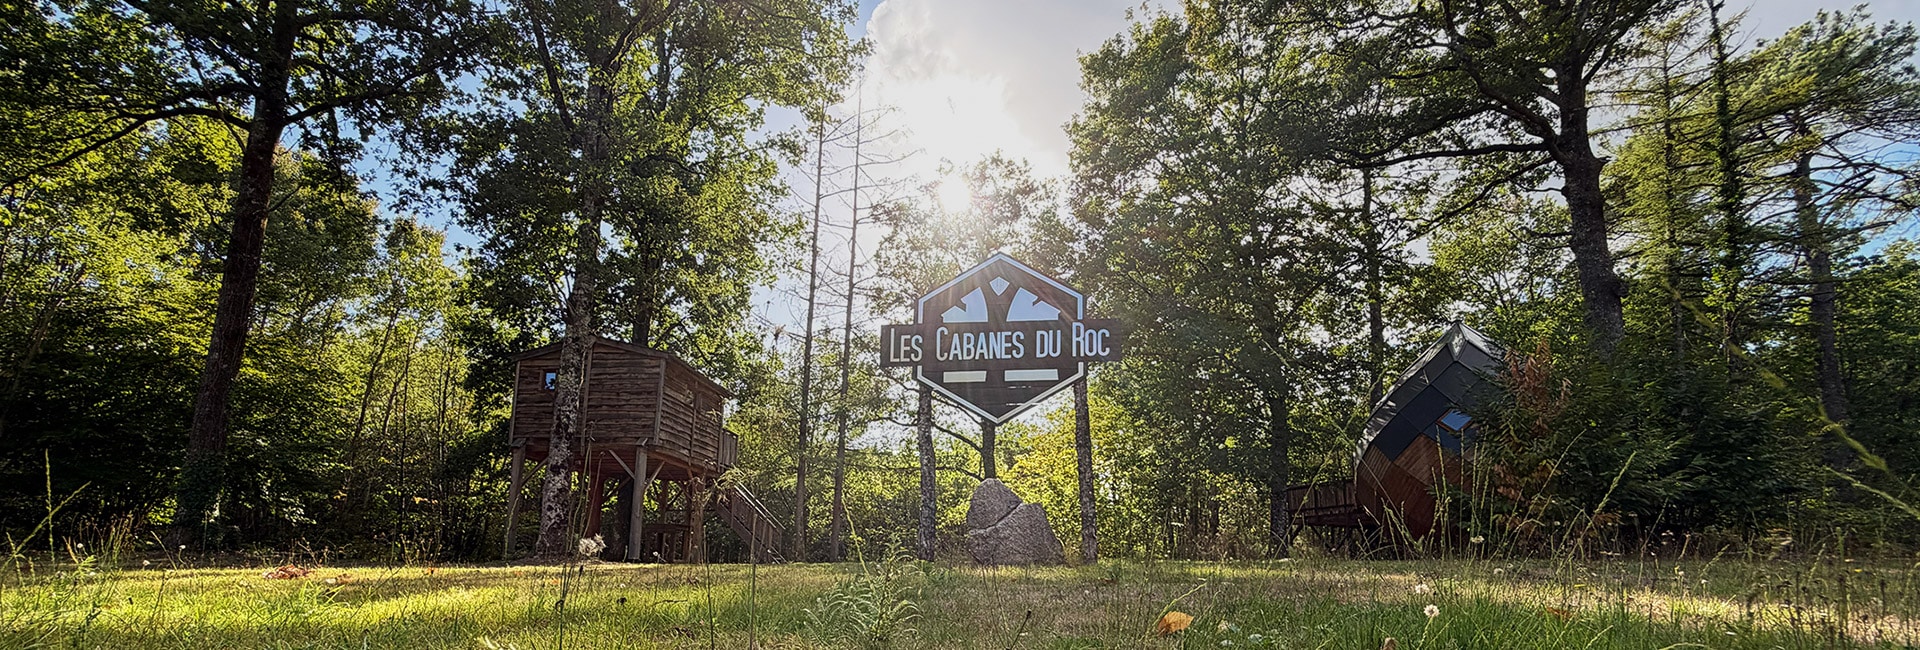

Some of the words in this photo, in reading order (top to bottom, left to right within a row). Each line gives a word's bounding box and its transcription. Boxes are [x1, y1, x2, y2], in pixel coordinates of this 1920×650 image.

[889, 327, 923, 363] LES
[936, 326, 1025, 361] CABANES
[1035, 329, 1061, 358] DU
[1071, 321, 1111, 357] ROC
